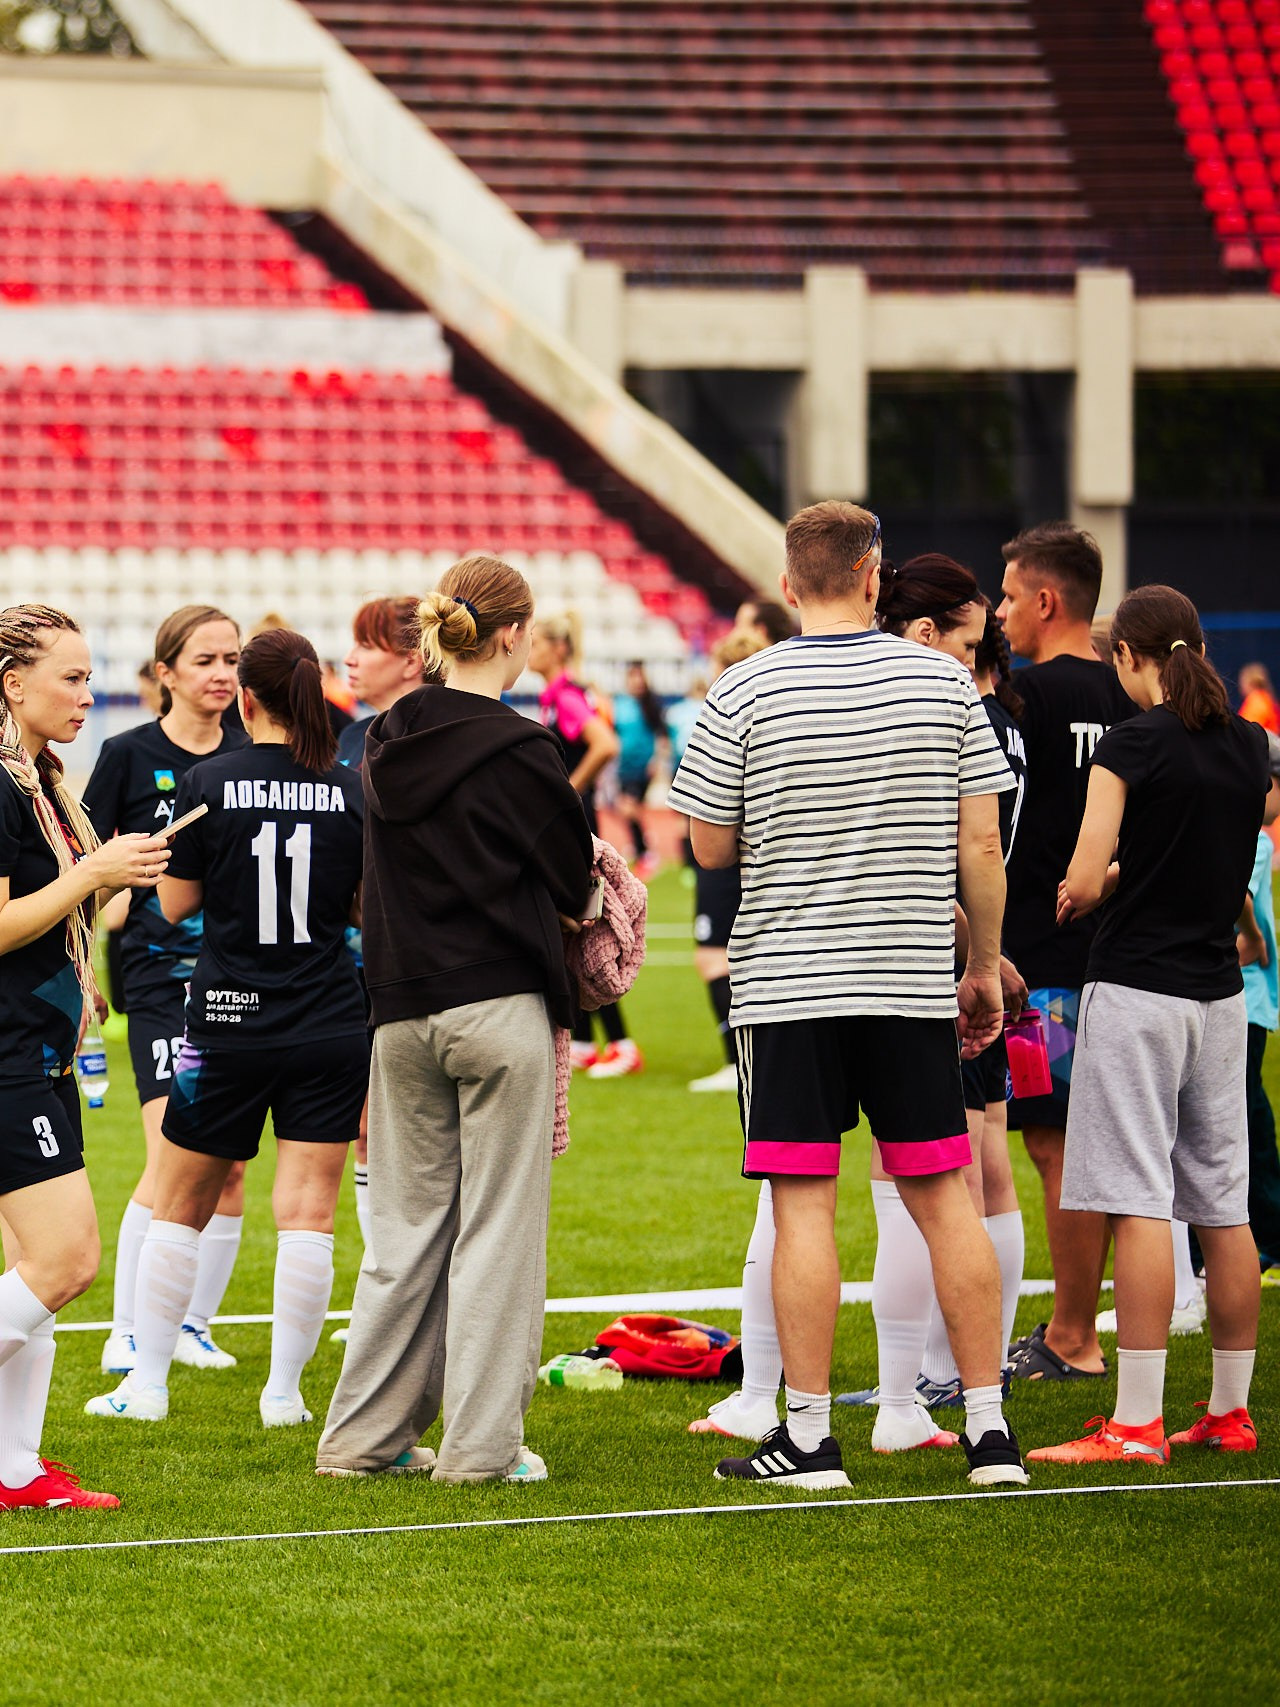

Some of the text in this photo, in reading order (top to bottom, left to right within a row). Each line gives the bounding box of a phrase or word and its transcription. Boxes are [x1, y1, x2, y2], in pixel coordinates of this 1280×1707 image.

[223, 780, 346, 812] ЛОБАНОВА
[251, 821, 312, 945] 11
[206, 990, 259, 1003] ФУТБОЛ
[206, 1013, 241, 1022] 25-20-28
[32, 1115, 60, 1158] 3
